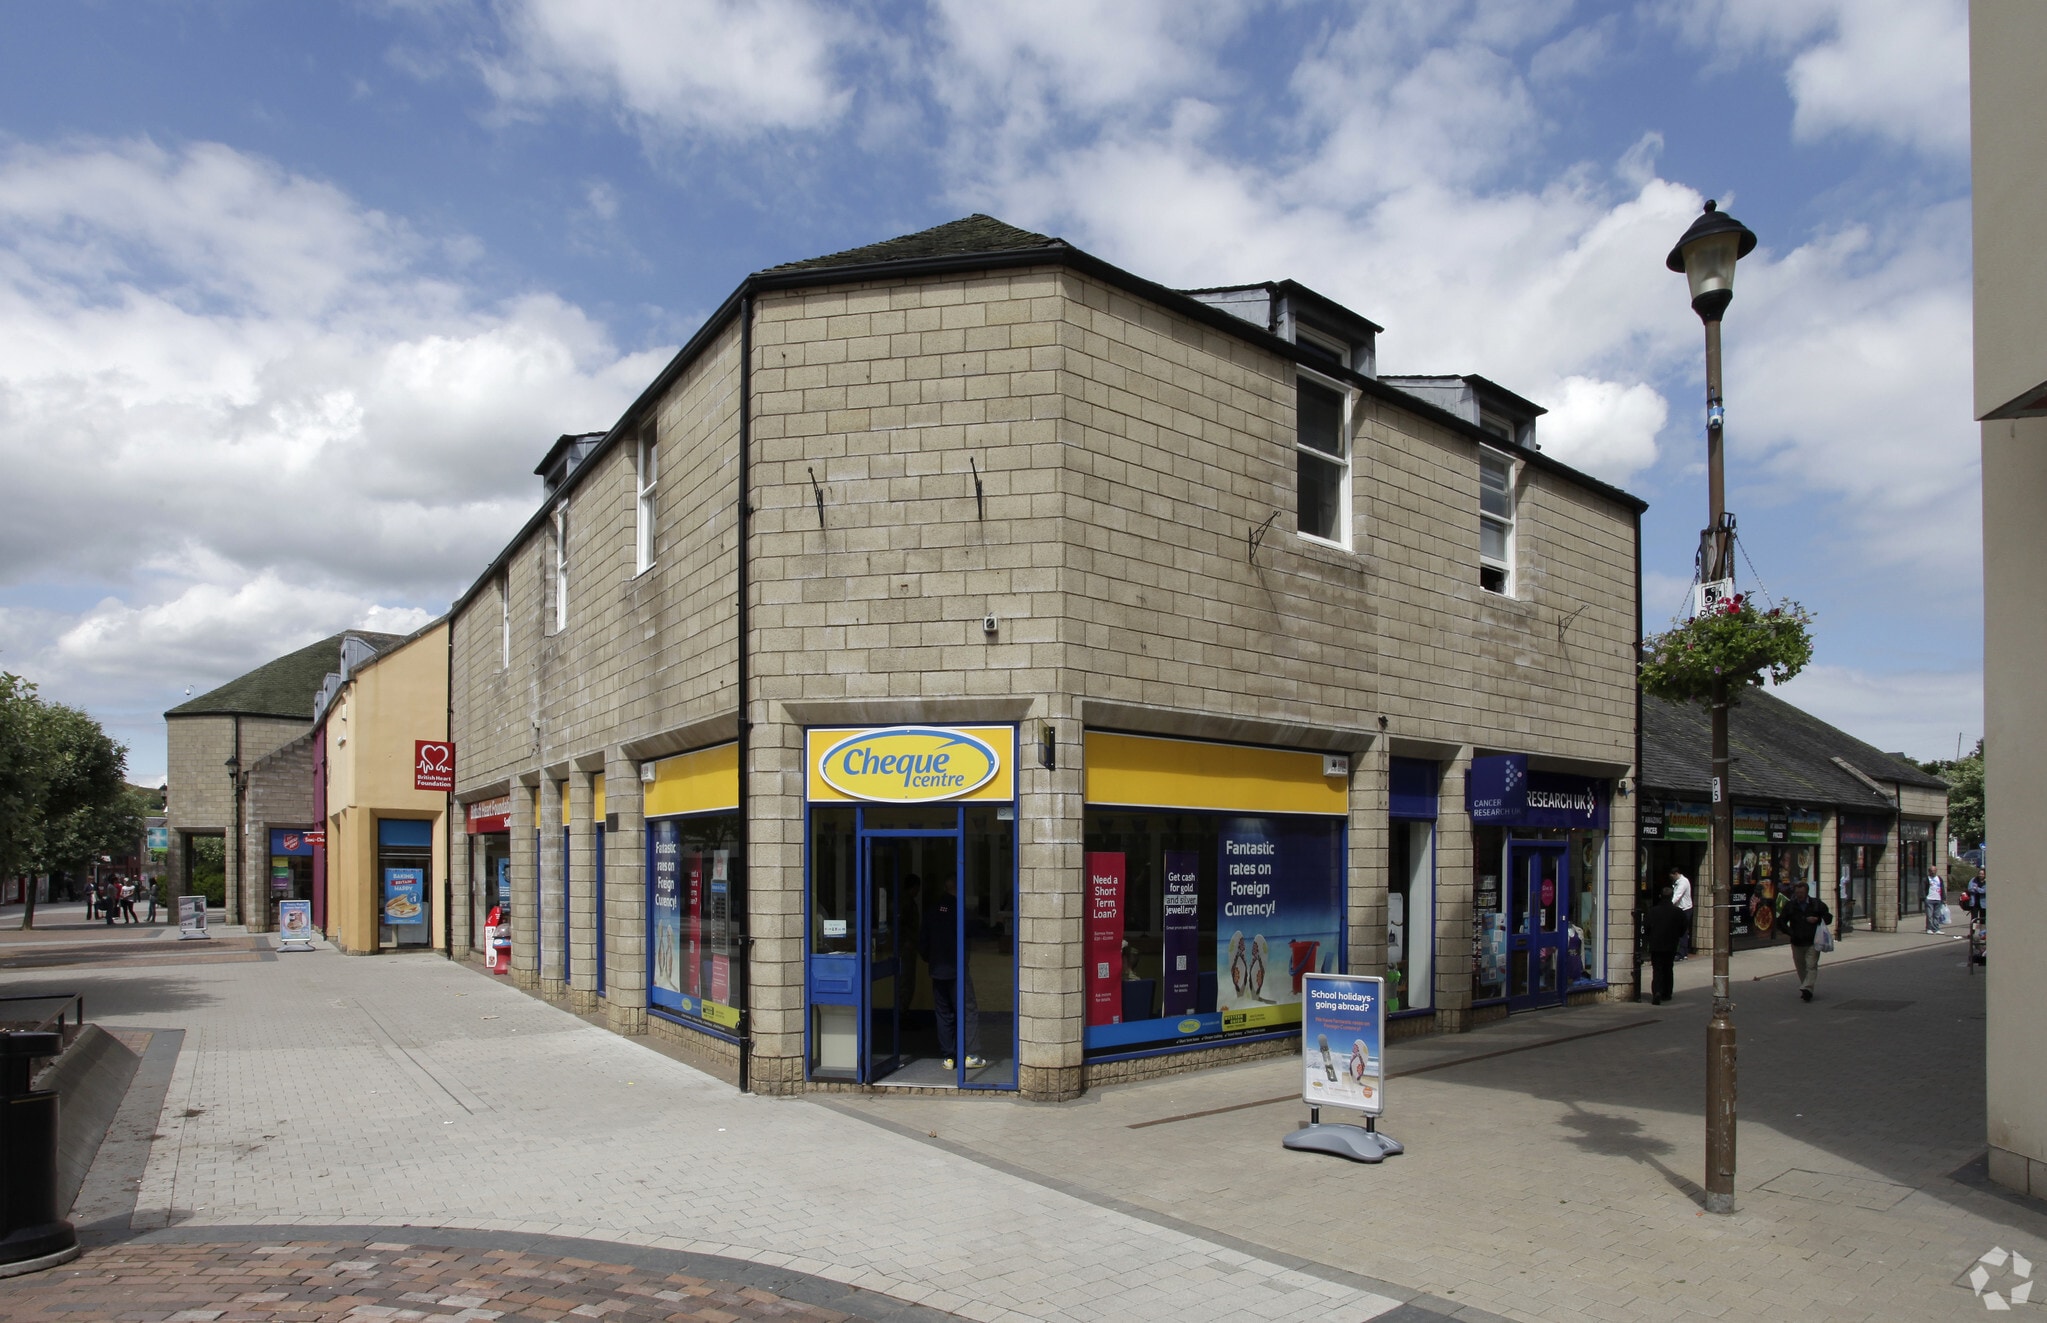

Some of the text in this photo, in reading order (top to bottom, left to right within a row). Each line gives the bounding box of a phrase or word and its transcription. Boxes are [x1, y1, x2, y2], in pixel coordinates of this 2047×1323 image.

[843, 748, 950, 788] Cheque
[912, 772, 965, 787] centre
[1474, 798, 1502, 808] CANCER
[1526, 791, 1586, 810] RESEARCH UK
[1474, 808, 1510, 817] RESEARCH
[1226, 840, 1274, 855] Fantastic
[1229, 862, 1272, 876] rates on
[1093, 875, 1112, 885] Need
[1168, 872, 1196, 882] Get cash
[1095, 886, 1116, 896] Short
[1170, 883, 1194, 894] for gold
[1230, 880, 1270, 898] Foreign
[1095, 898, 1116, 908] Term
[1180, 896, 1196, 905] silver
[1093, 909, 1117, 919] Loan?
[1165, 905, 1197, 916] jewellery!
[1225, 900, 1276, 918] Currency!
[1311, 990, 1375, 1003] School holidays-
[1315, 1001, 1370, 1012] going abroad?
